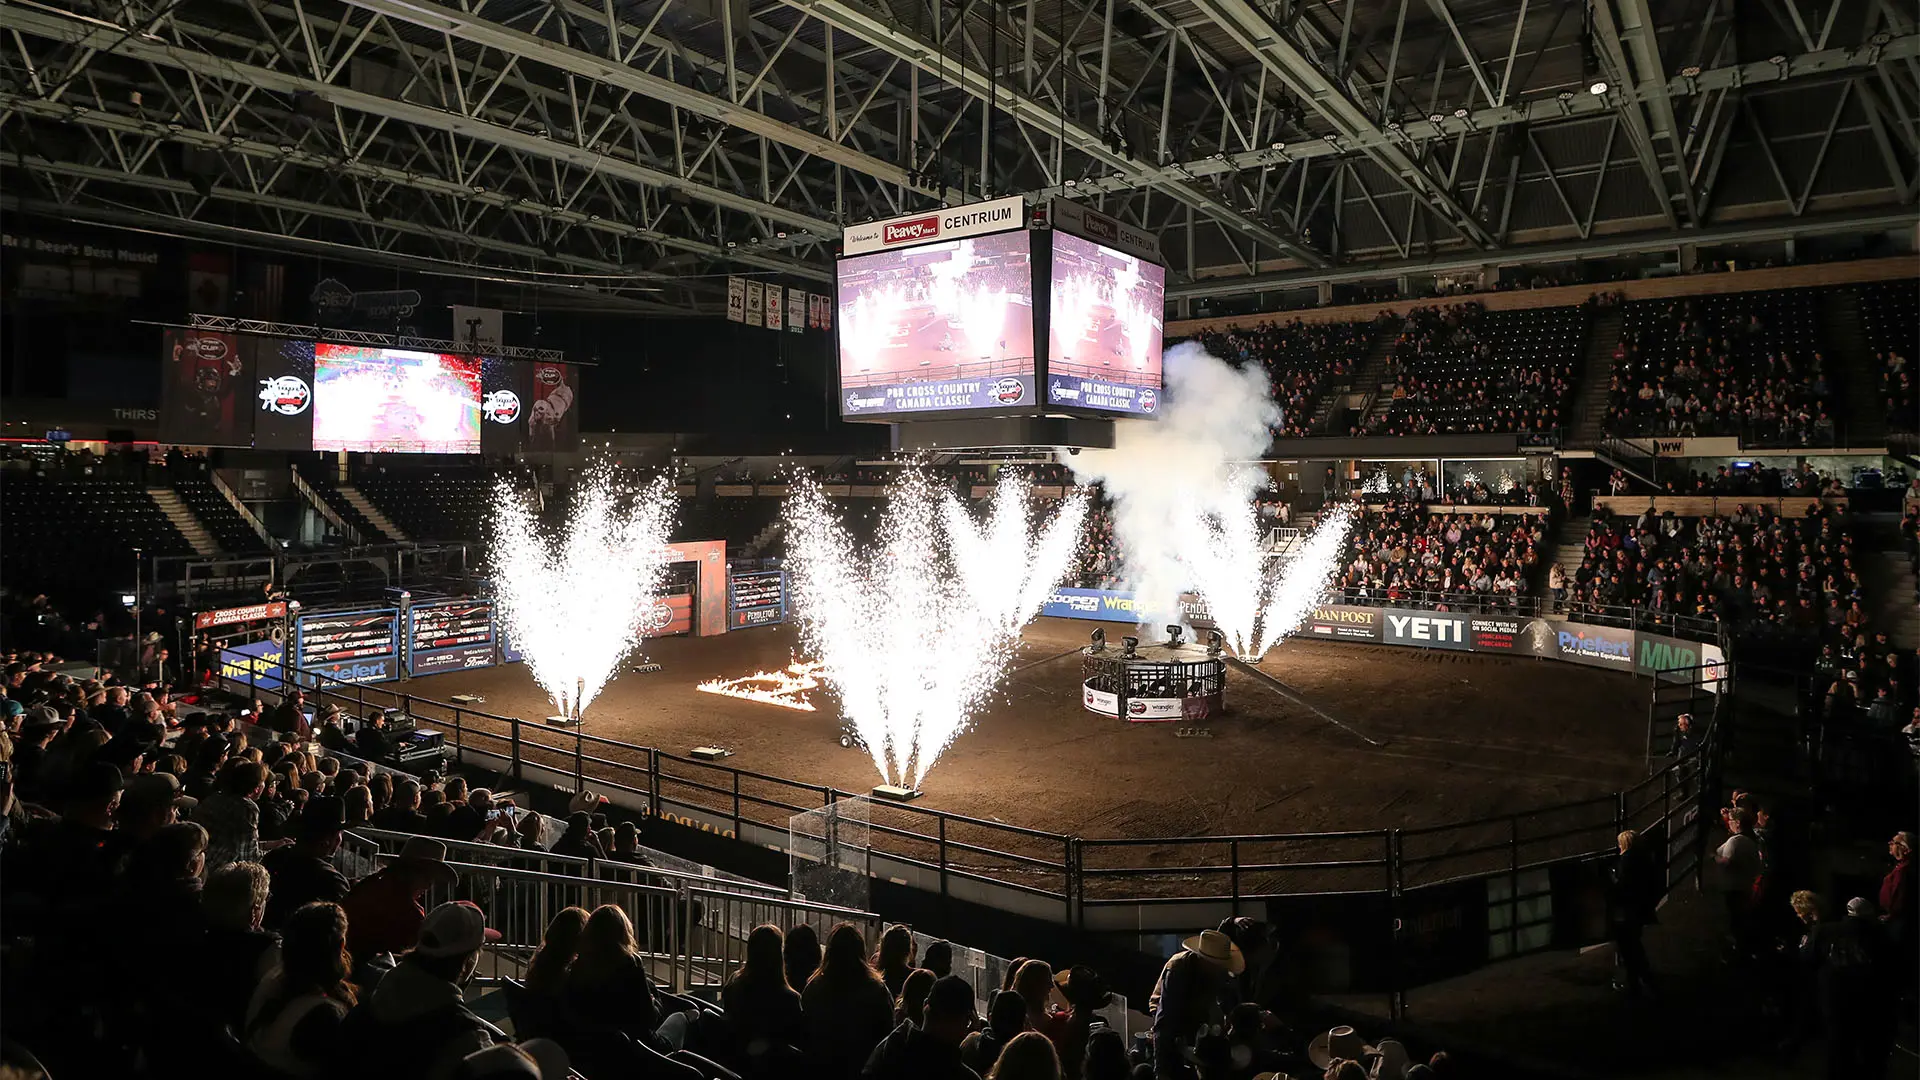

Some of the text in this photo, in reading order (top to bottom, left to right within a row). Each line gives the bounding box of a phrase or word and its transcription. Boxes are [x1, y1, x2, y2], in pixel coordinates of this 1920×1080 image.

[944, 207, 1012, 230] CENTRIUM
[886, 223, 924, 242] Peavey
[1120, 230, 1155, 252] CENTRIUM
[35, 239, 80, 256] Deer's
[83, 245, 114, 259] Best
[886, 382, 981, 399] PBR CROSS COUNTRY
[1093, 383, 1111, 396] CROSS
[895, 395, 932, 409] CANADA
[934, 394, 972, 406] CLASSIC
[1109, 396, 1131, 408] CLASSIC
[213, 611, 267, 624] CANADA CLASSIC
[214, 605, 267, 618] CROSS COUNTRY
[747, 607, 775, 621] PENDLETON
[1314, 609, 1374, 625] DAN POST
[1387, 615, 1462, 643] YETI
[1558, 631, 1630, 656] Priefert
[464, 655, 490, 668] Ford
[1582, 649, 1600, 657] Ranch
[1600, 651, 1631, 663] Equipment
